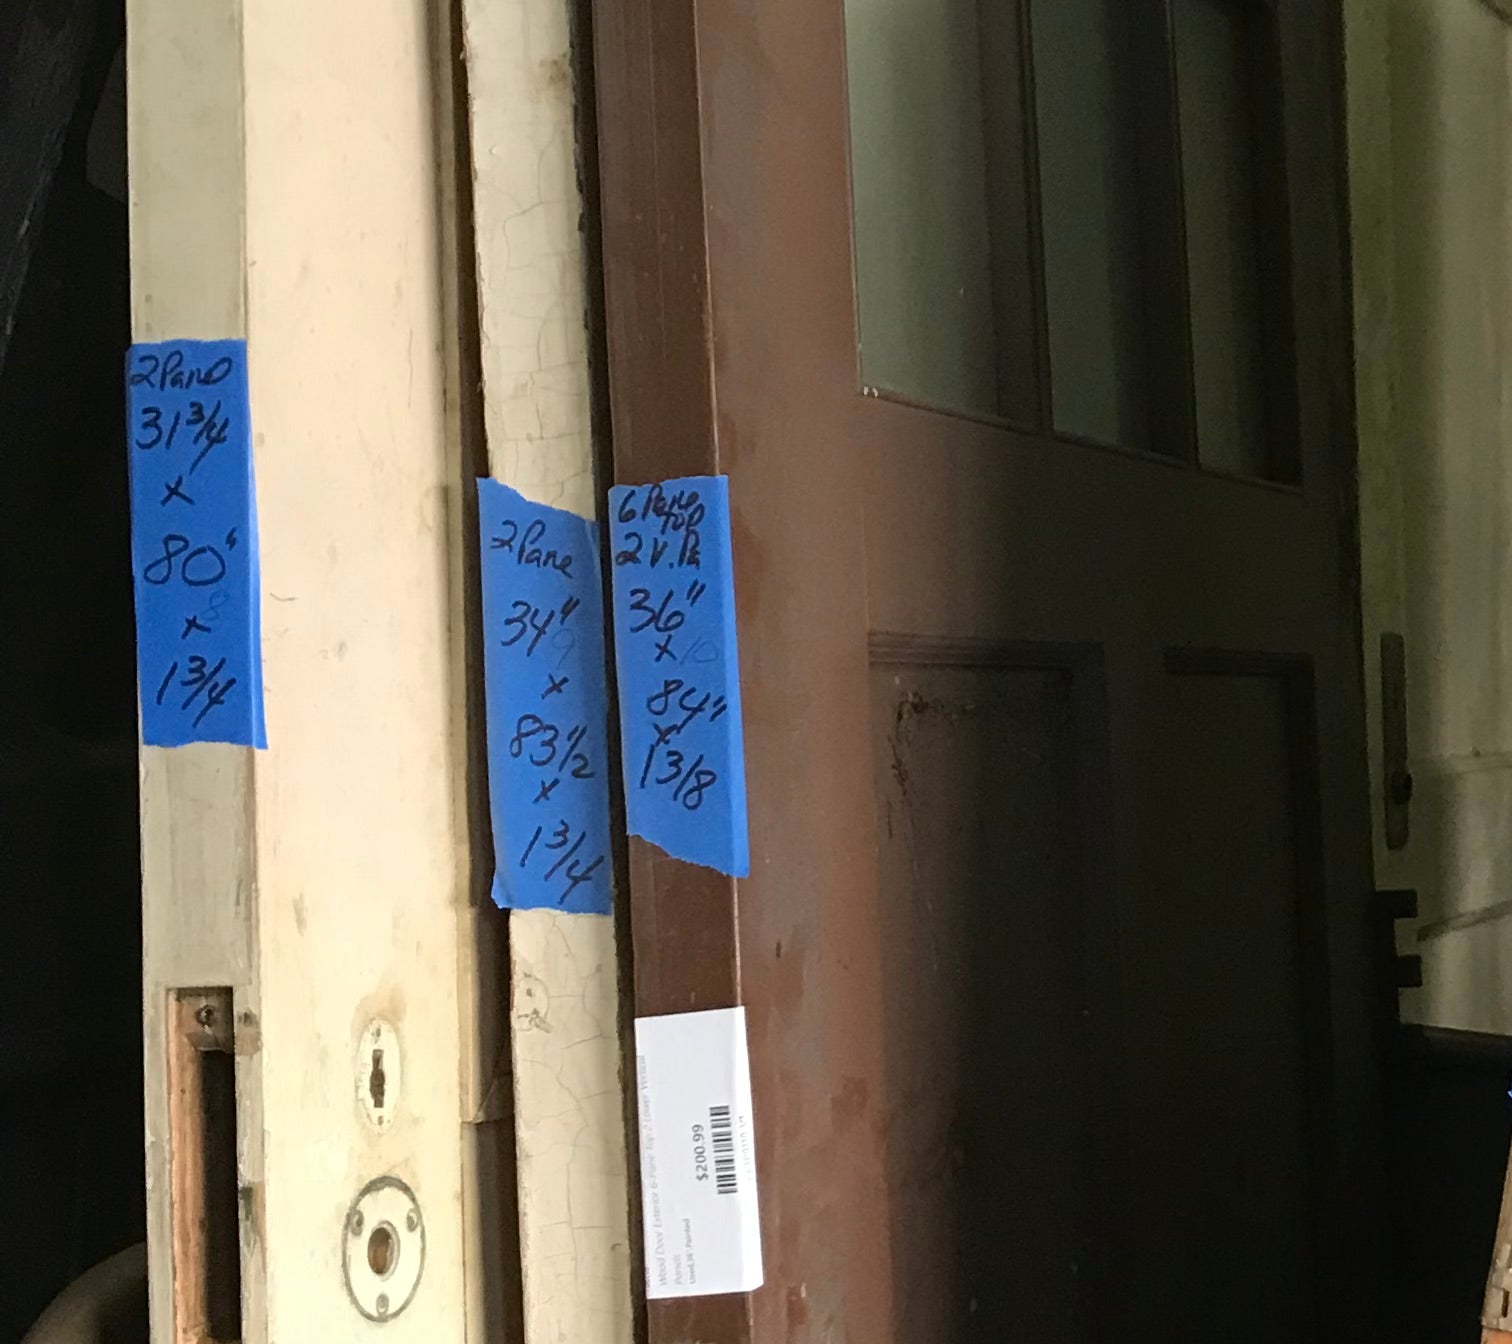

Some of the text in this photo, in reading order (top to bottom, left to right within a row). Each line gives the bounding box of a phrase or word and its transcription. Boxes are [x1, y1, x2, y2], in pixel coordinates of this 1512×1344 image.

[136, 400, 230, 475] 31 3/4
[692, 1124, 709, 1181] $200.99
